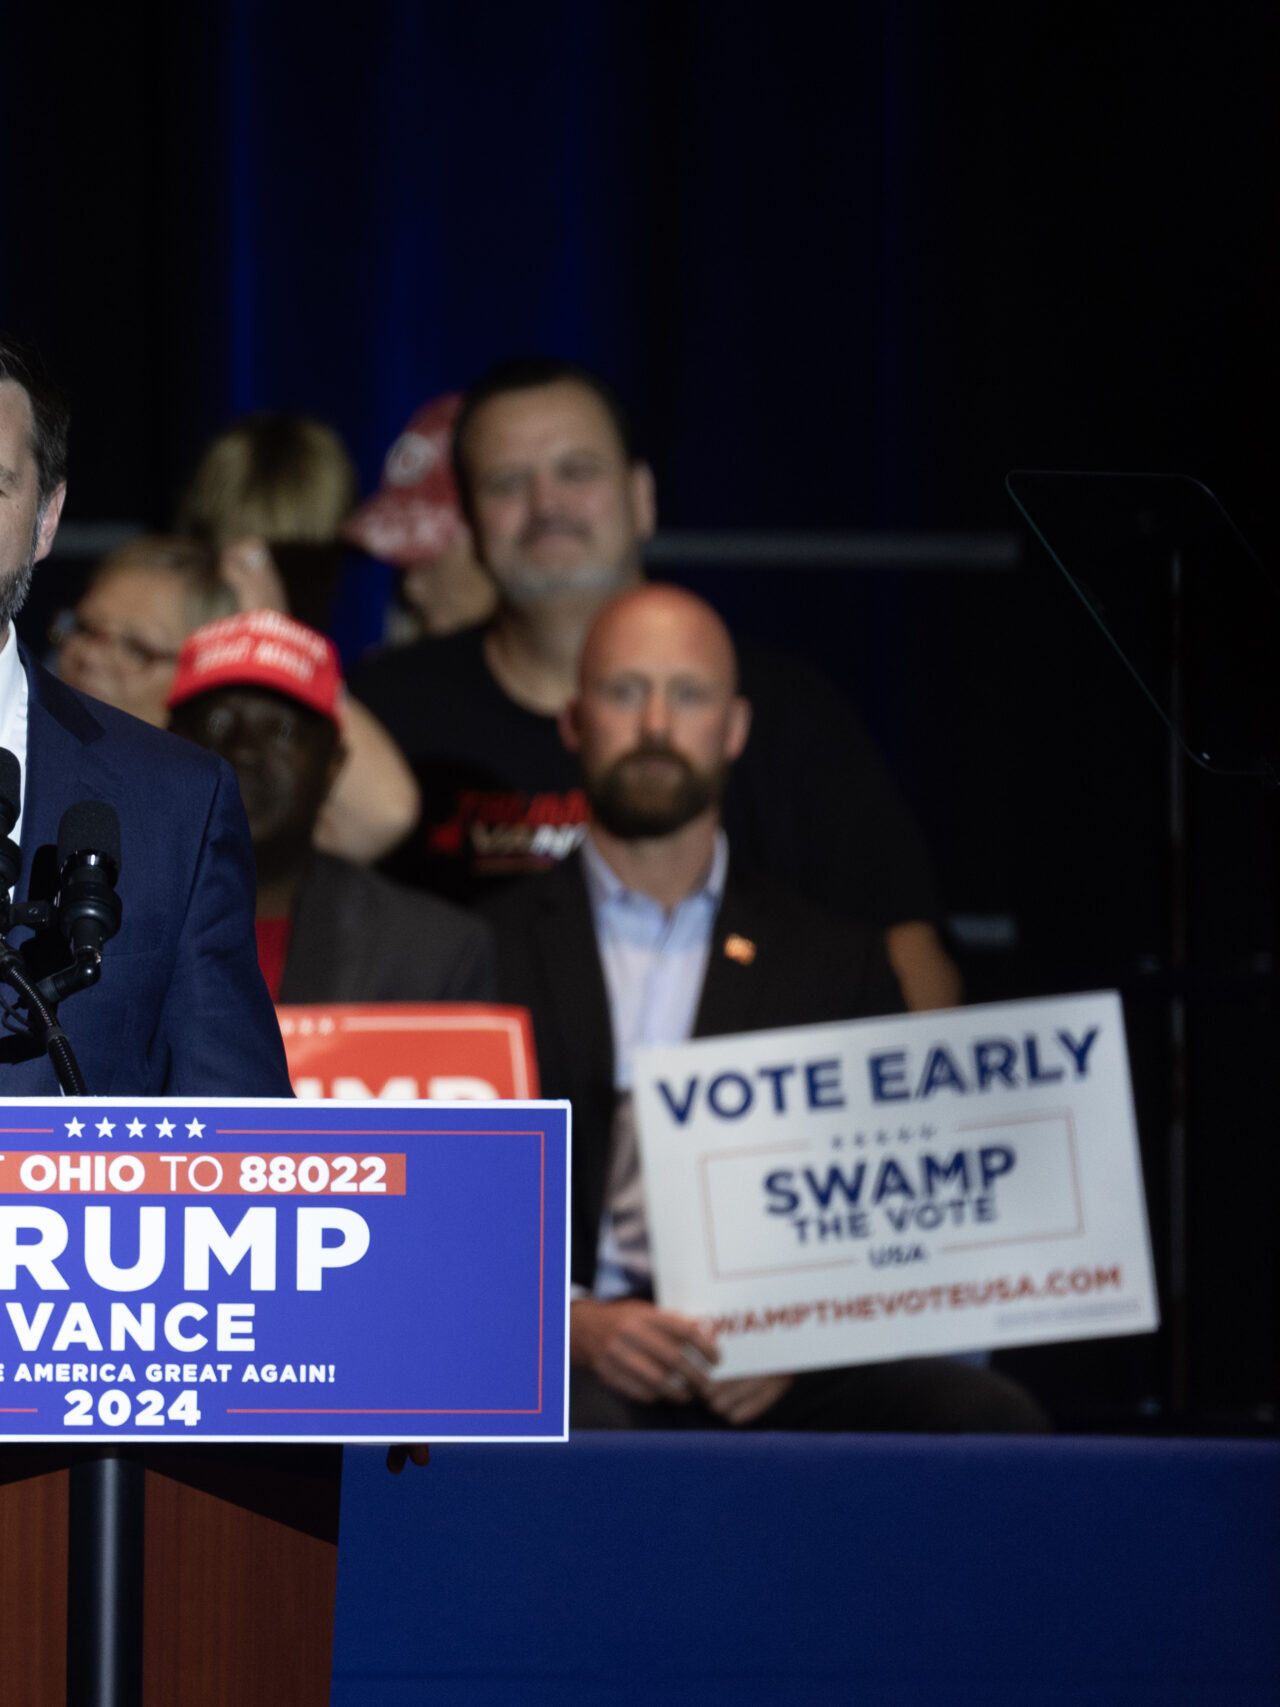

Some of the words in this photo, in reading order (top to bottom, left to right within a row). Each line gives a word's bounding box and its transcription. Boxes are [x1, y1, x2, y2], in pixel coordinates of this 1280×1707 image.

[657, 1057, 846, 1127] VOTE
[867, 1023, 1101, 1105] EARLY
[19, 1153, 146, 1192] OHIO
[160, 1155, 224, 1192] TO
[239, 1155, 387, 1193] 88022
[763, 1143, 1017, 1217] SWAMP
[793, 1211, 870, 1244] THE
[886, 1197, 998, 1234] VOTE
[868, 1243, 928, 1269] USA
[6, 1302, 255, 1352] VANCE
[14, 1363, 136, 1382] AMERICA
[146, 1363, 232, 1382] GREAT
[242, 1364, 336, 1383] AGAIN!
[64, 1389, 201, 1426] 2024
